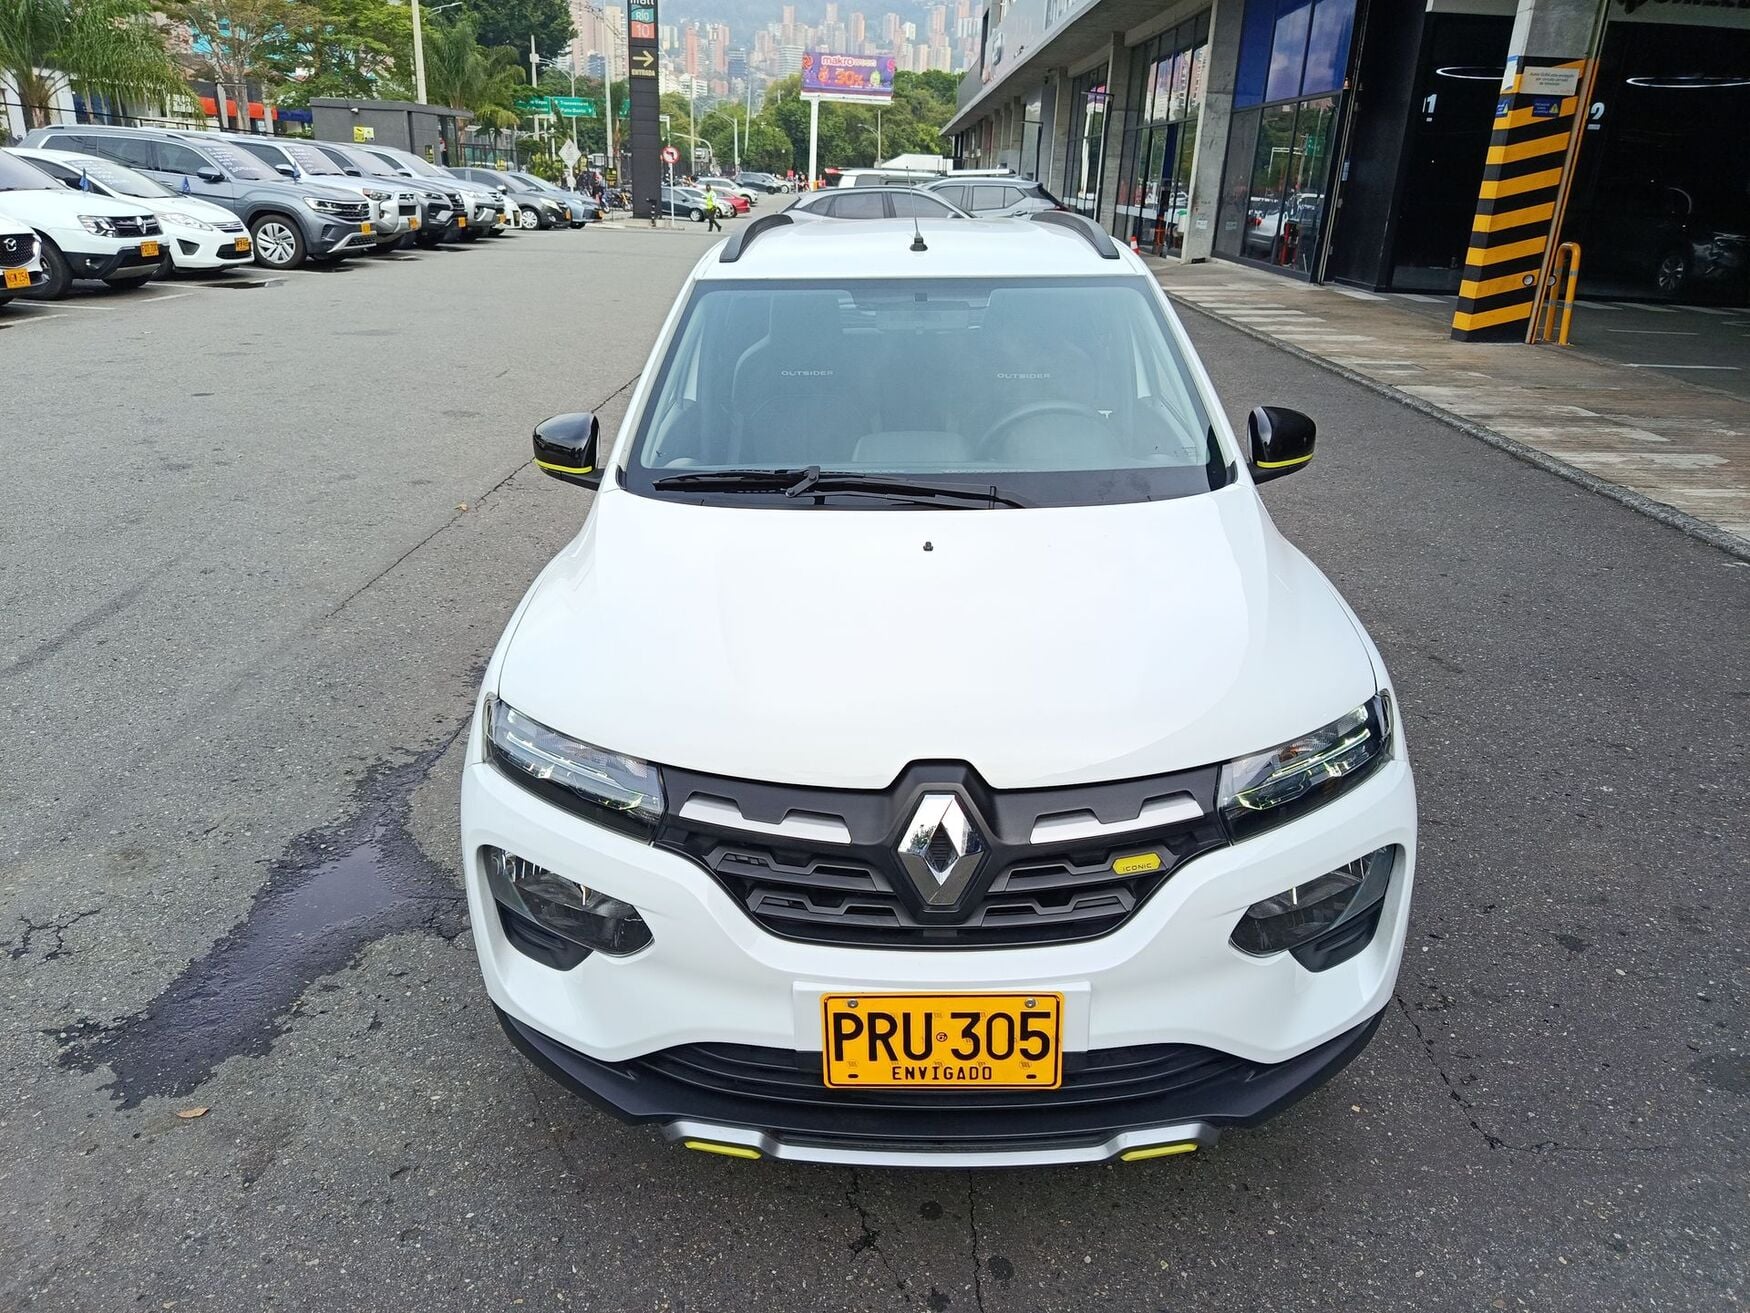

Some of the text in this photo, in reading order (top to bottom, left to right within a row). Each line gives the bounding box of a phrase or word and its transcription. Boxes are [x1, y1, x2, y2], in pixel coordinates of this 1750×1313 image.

[1122, 863, 1152, 872] ICONIC
[832, 1011, 1051, 1062] PRU 305
[892, 1066, 992, 1080] ENVIGADO
